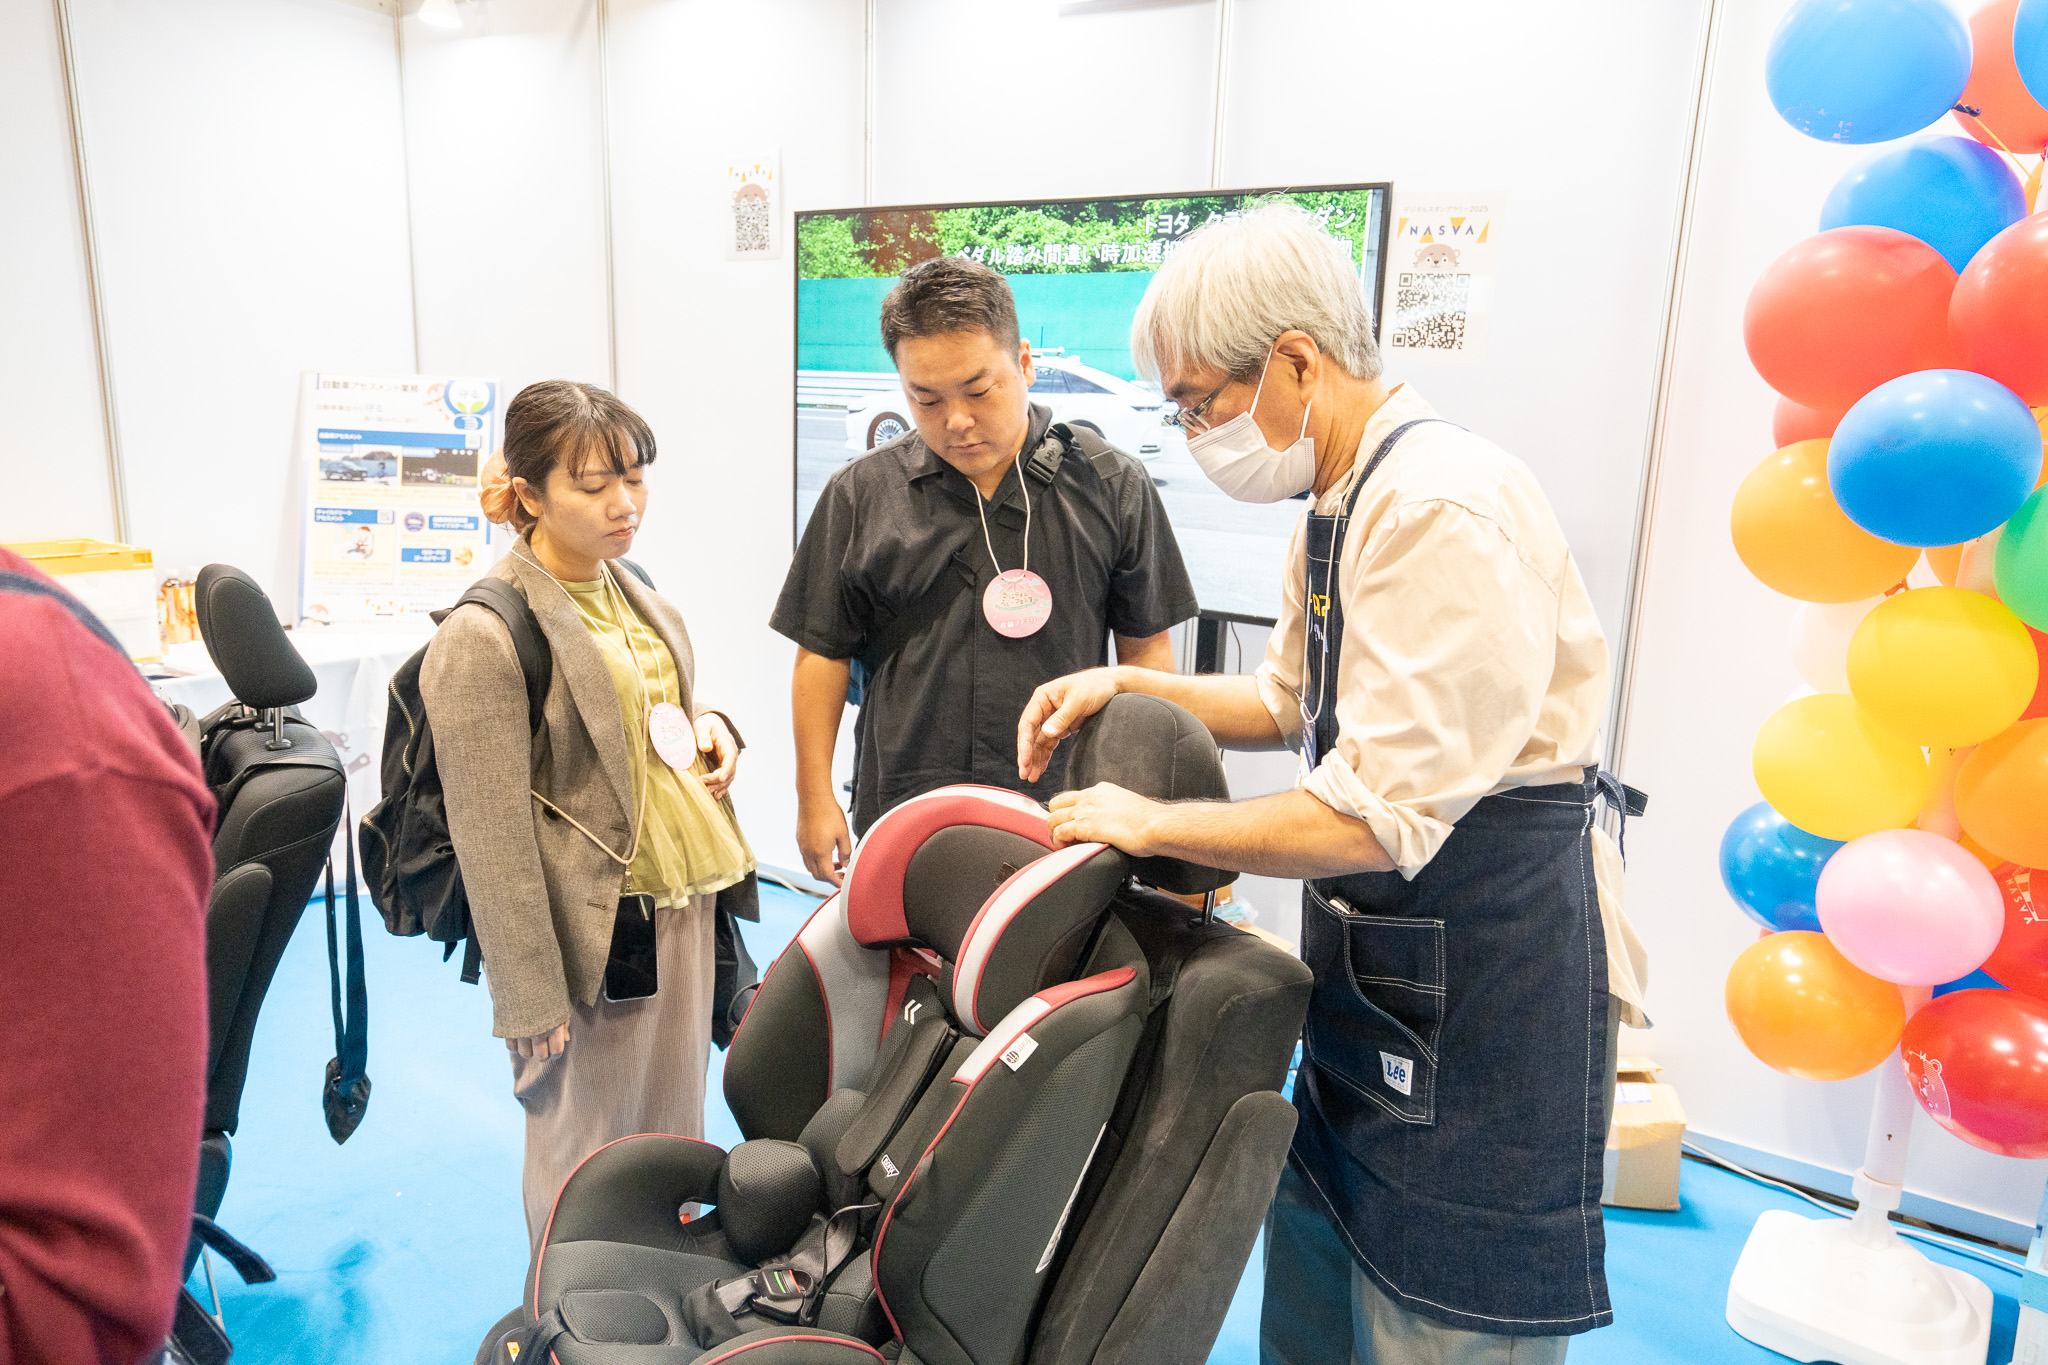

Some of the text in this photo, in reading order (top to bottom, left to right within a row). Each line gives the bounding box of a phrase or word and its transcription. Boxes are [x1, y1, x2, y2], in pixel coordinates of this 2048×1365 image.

[1145, 211, 1190, 236] トヨタ
[1410, 225, 1474, 236] NASVA
[2005, 878, 2034, 925] NASVA
[1386, 1060, 1406, 1083] Lee
